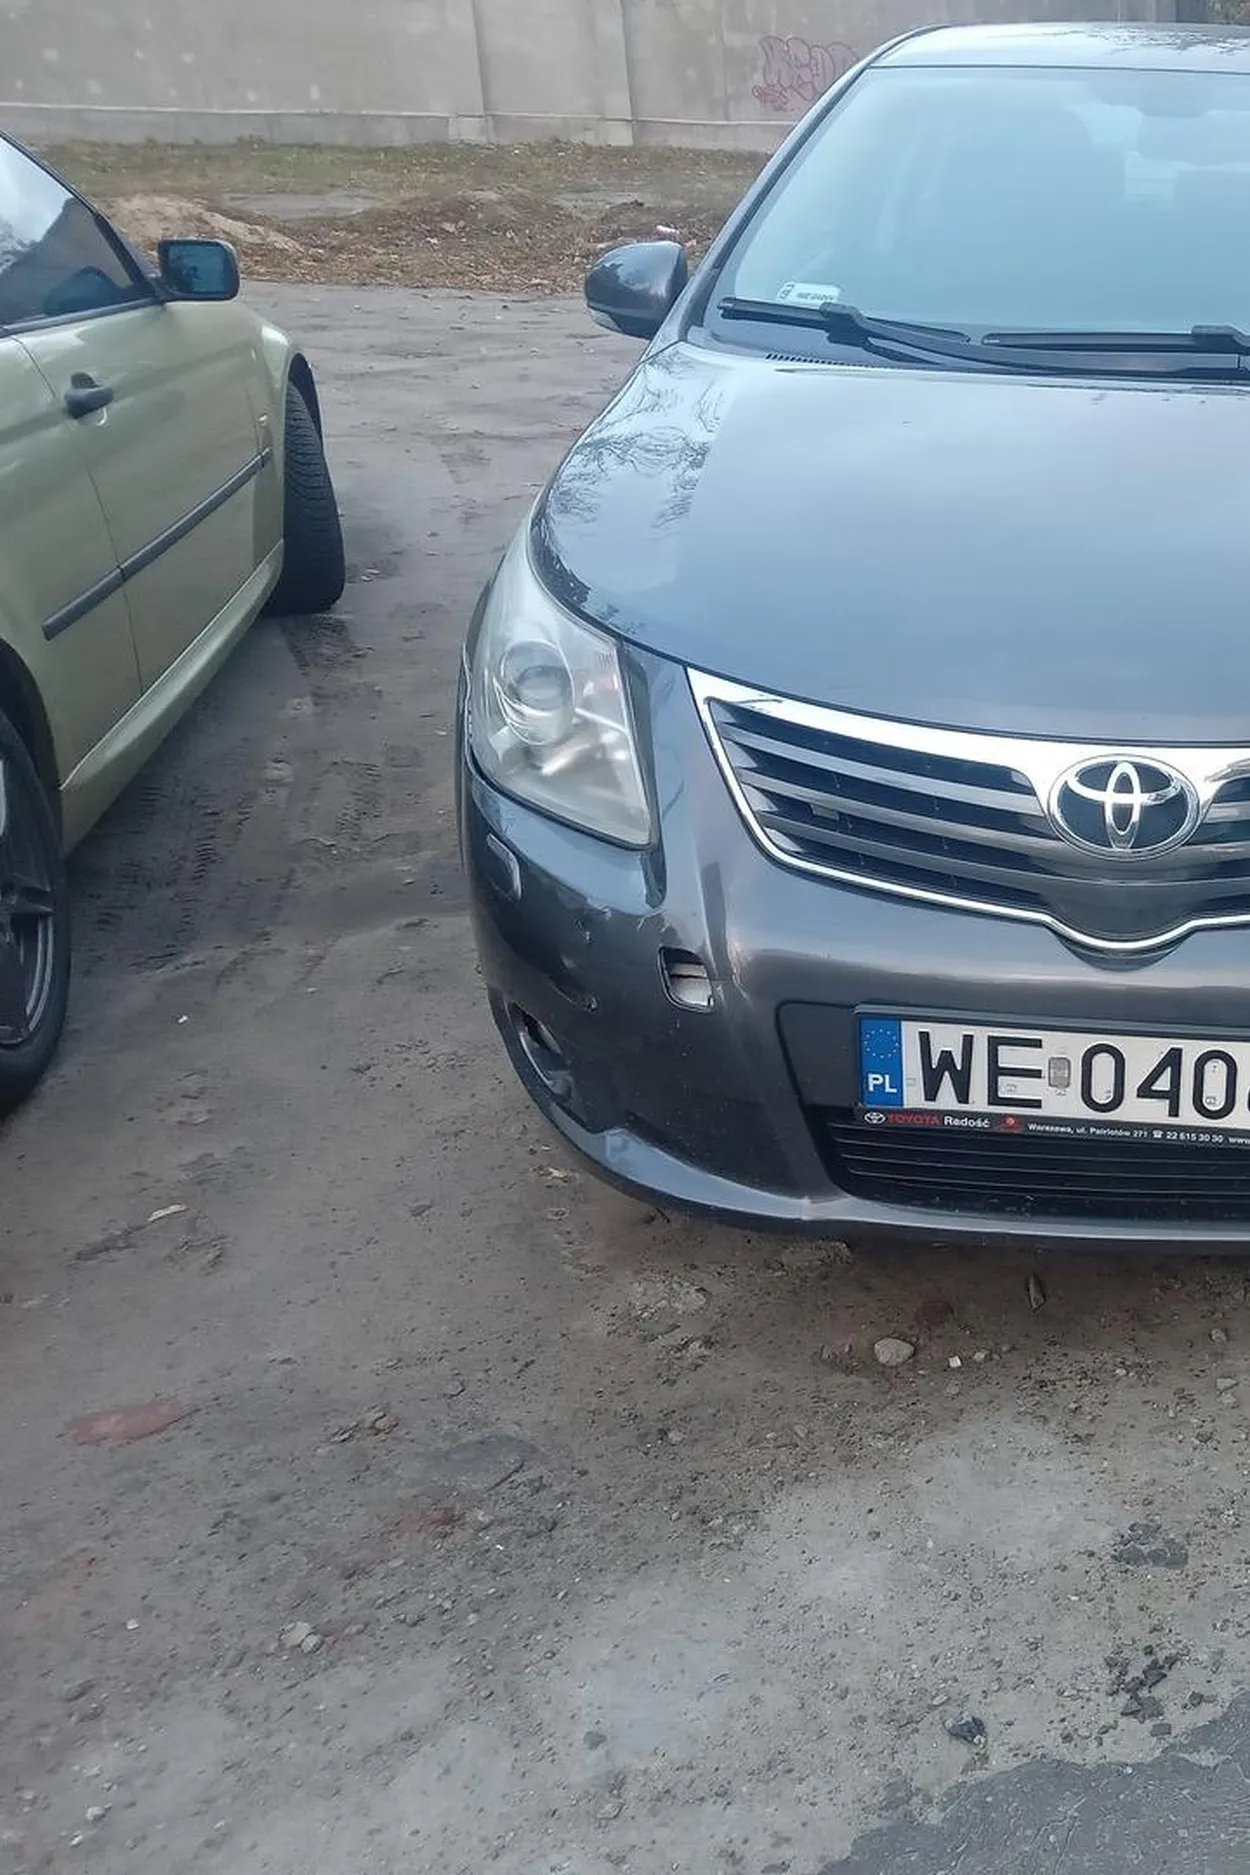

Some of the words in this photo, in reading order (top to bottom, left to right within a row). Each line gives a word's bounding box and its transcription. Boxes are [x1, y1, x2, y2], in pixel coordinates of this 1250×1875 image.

[918, 1031, 1042, 1109] WE
[867, 1074, 898, 1093] PL
[887, 1113, 940, 1126] TOYOTA
[944, 1115, 991, 1128] Radość
[1166, 1131, 1178, 1140] 22
